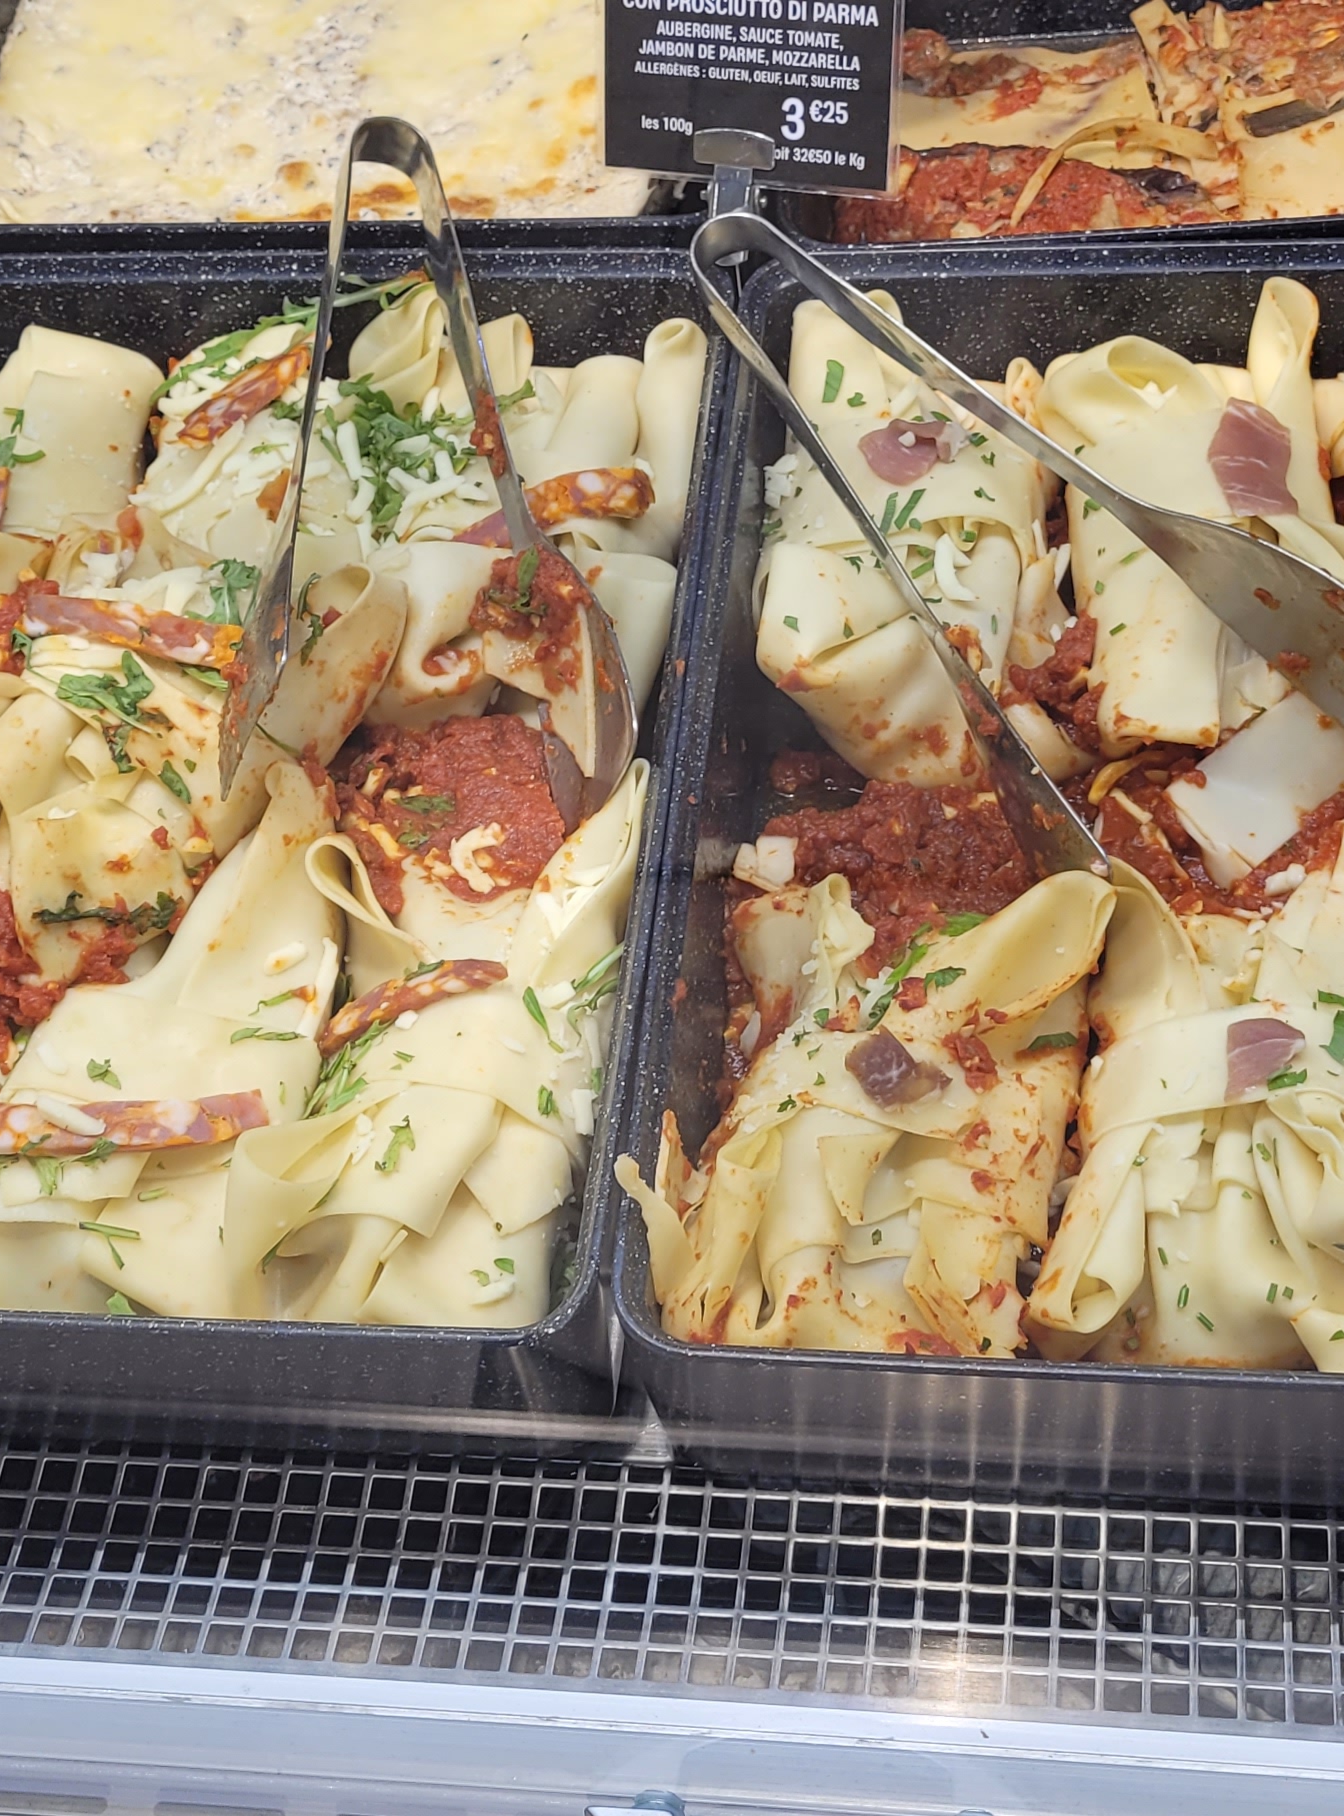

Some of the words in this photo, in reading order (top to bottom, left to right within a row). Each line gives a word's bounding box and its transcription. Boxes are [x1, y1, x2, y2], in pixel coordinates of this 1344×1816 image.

[667, 0, 782, 20] PROSCIUTTO
[788, 2, 806, 22] DI
[813, 4, 879, 27] PARMA
[656, 20, 737, 43] AUBERGINE,
[739, 27, 783, 45] SAUCE
[787, 30, 844, 51] TOMATE,
[639, 39, 694, 59] JAMBON
[698, 44, 715, 60] DE
[719, 47, 769, 67] PARME,
[772, 50, 860, 72] MOZZARELLA
[634, 60, 700, 78] ALLERGÈNES
[708, 66, 752, 84] GLUTEN,
[753, 71, 783, 86] OEUF,
[784, 73, 809, 88] LAIT,
[811, 77, 860, 91] SULFITES
[641, 115, 659, 131] les
[663, 116, 694, 136] 100g
[780, 97, 806, 141] 3
[809, 100, 849, 125] €25
[775, 146, 790, 161] oit
[792, 147, 832, 165] 32€50
[834, 151, 846, 166] le
[849, 152, 866, 171] Kg
